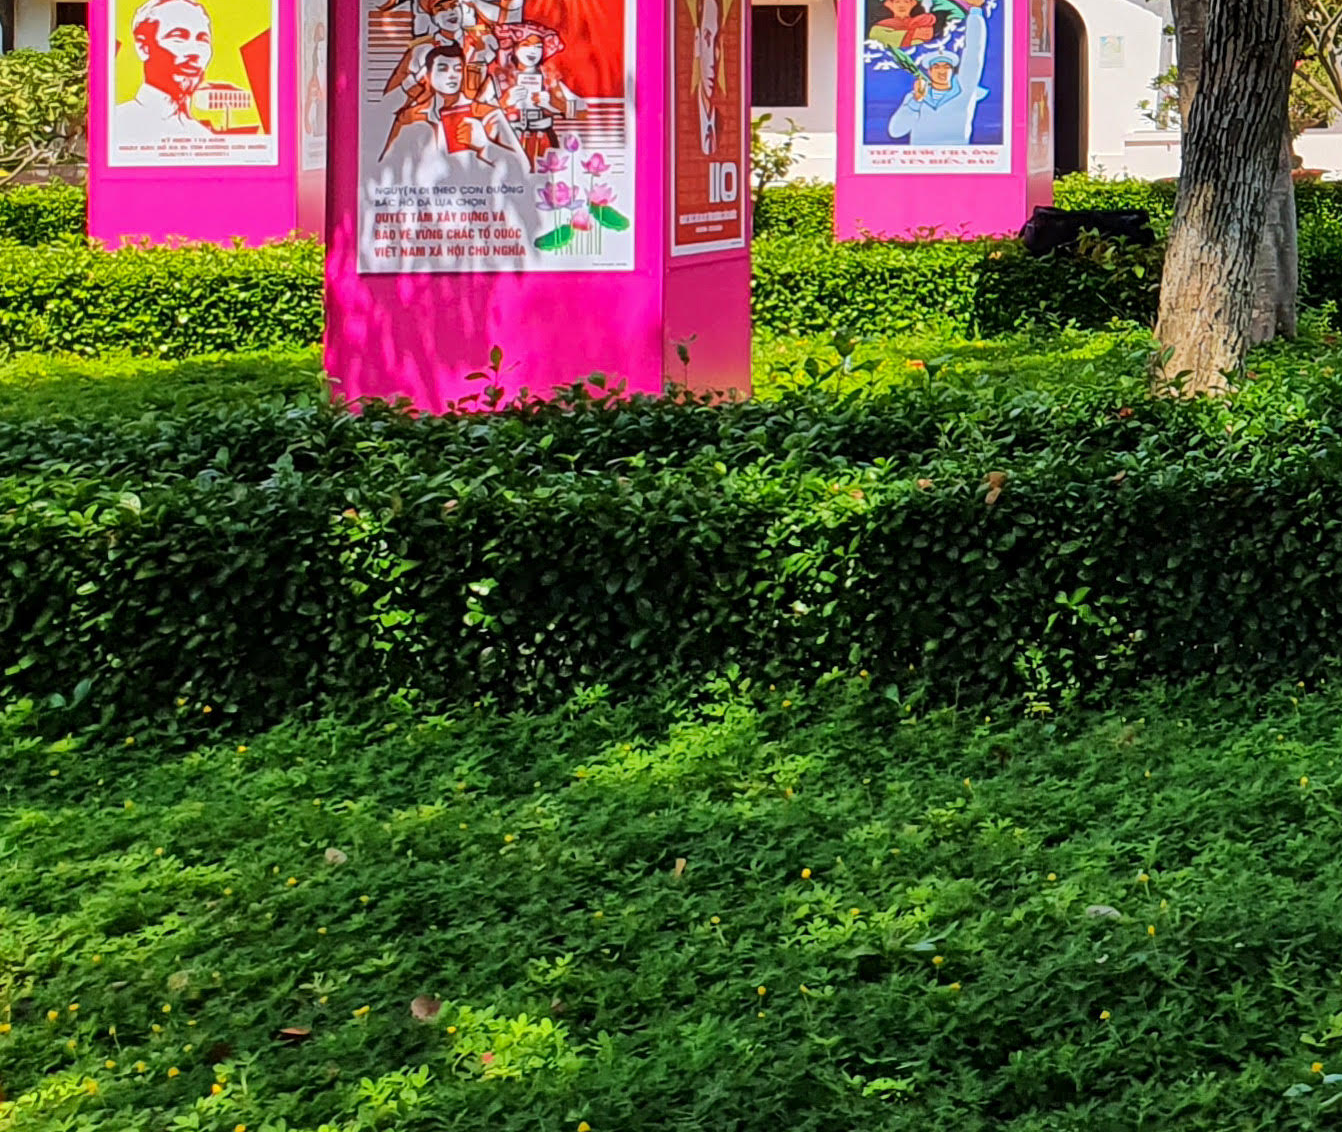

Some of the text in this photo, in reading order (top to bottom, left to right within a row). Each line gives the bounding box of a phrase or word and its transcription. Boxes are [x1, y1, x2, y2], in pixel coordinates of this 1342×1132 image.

[709, 162, 738, 203] 110
[433, 186, 456, 194] THEO
[460, 186, 483, 194] CON
[375, 245, 397, 258] VIỆT
[400, 246, 425, 256] NAM
